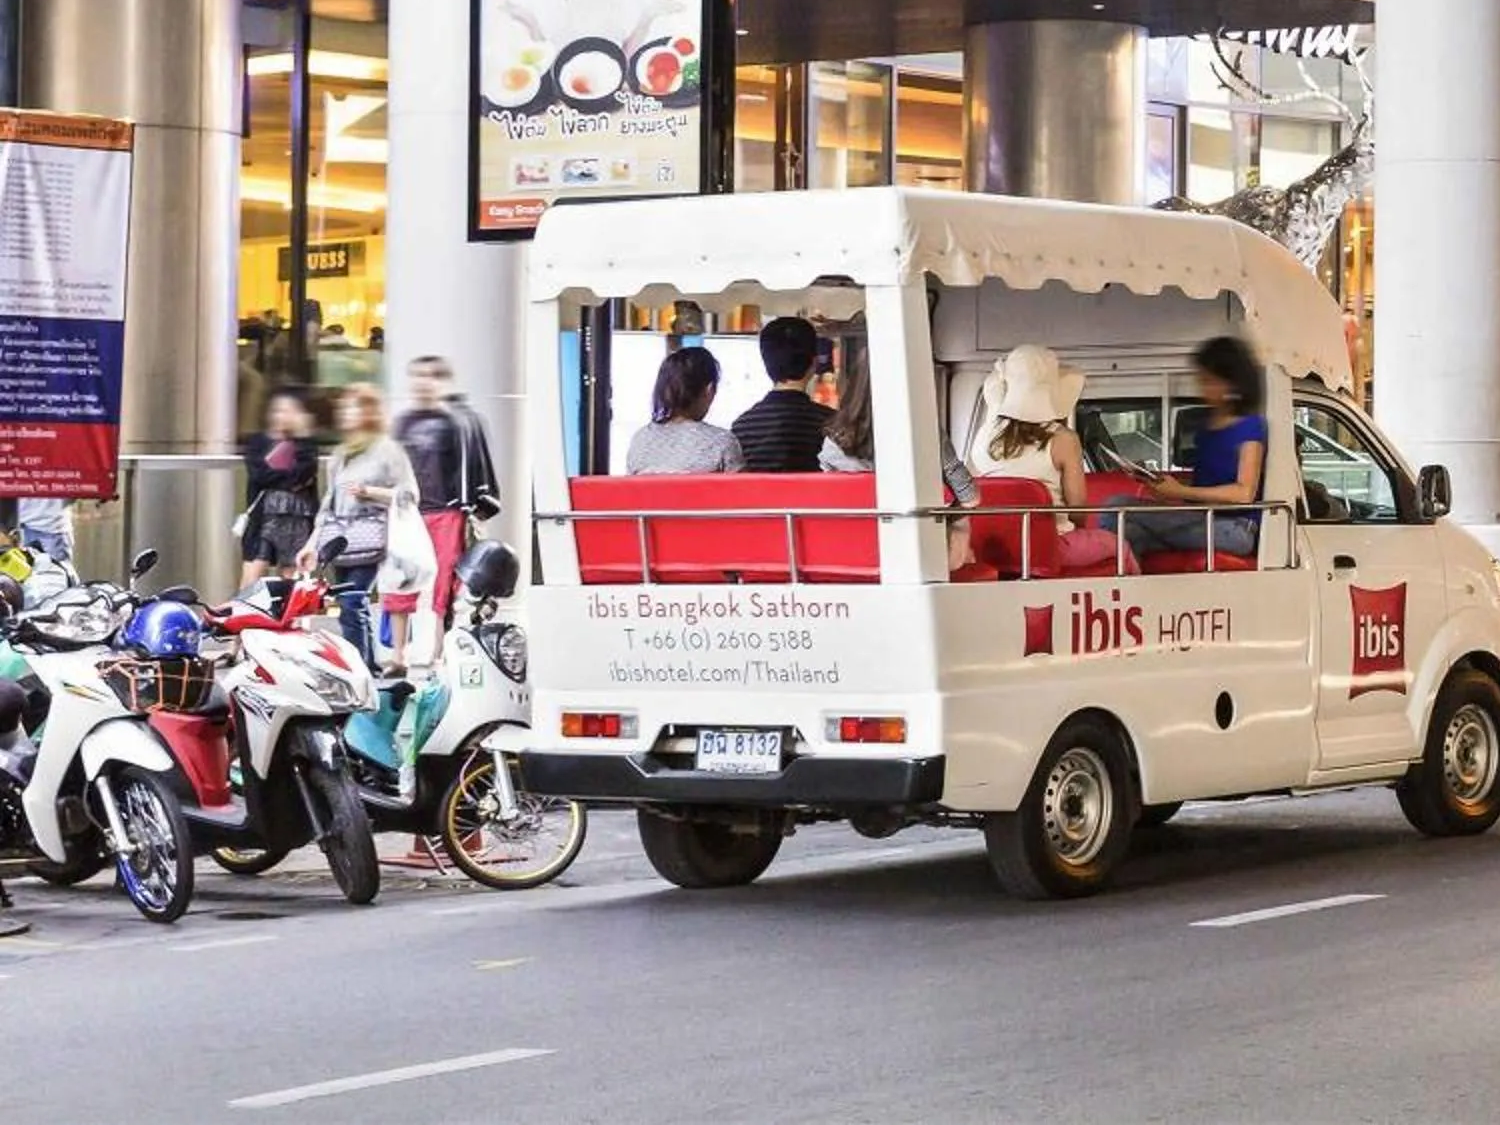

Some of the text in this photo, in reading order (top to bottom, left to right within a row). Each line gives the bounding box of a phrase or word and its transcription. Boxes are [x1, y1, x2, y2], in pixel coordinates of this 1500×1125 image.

[308, 251, 346, 270] UESS
[587, 590, 850, 626] ibis Bangkok Sathorn
[1071, 588, 1144, 658] ibis
[1359, 613, 1400, 658] ibis
[623, 628, 636, 651] T
[716, 630, 762, 650] 2610
[768, 629, 813, 652] 5188
[608, 660, 840, 685] ibishotel.com/Thailand
[735, 734, 778, 756] 8132
